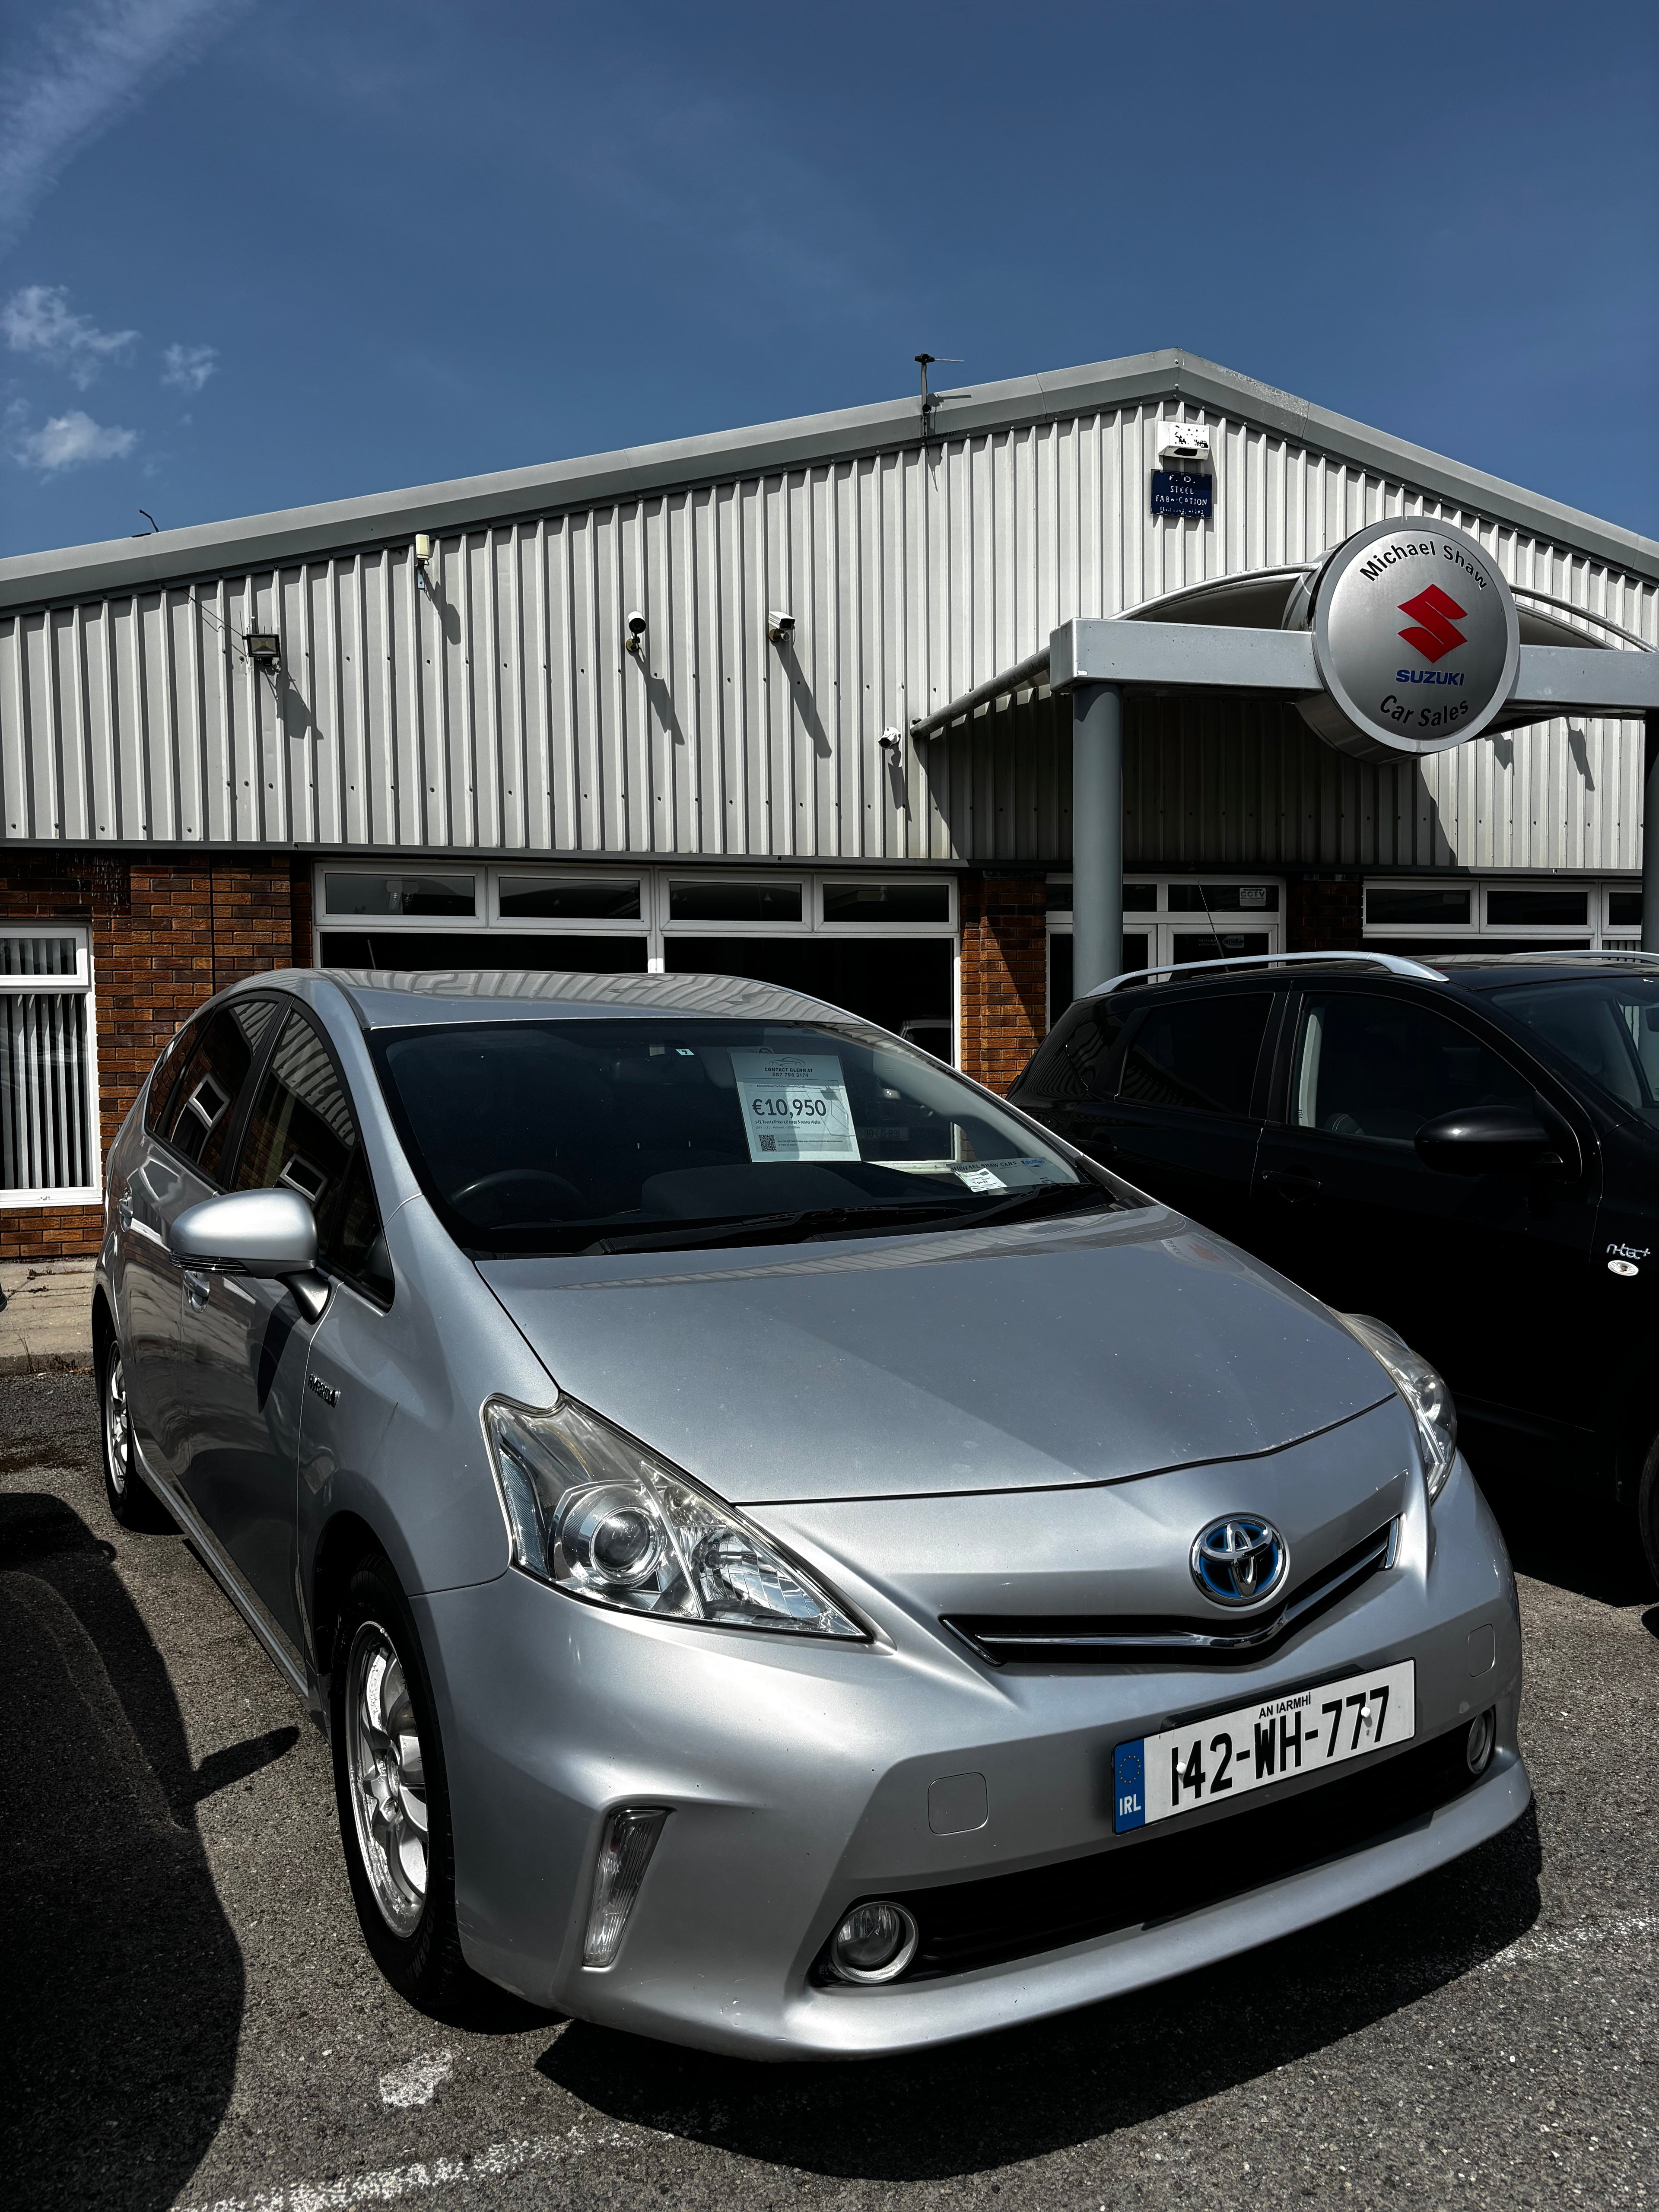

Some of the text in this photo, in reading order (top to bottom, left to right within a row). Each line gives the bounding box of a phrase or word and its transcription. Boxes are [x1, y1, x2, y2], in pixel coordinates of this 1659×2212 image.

[1359, 540, 1487, 589] Michael Shaw
[1396, 669, 1465, 686] SUZUKI
[1380, 695, 1468, 727] Car Sales
[752, 1099, 826, 1119] €10,950
[1258, 1691, 1311, 1719] AN IARMHÍ
[1171, 1685, 1389, 1806] 142-WH-777
[1119, 1793, 1141, 1816] IRL
